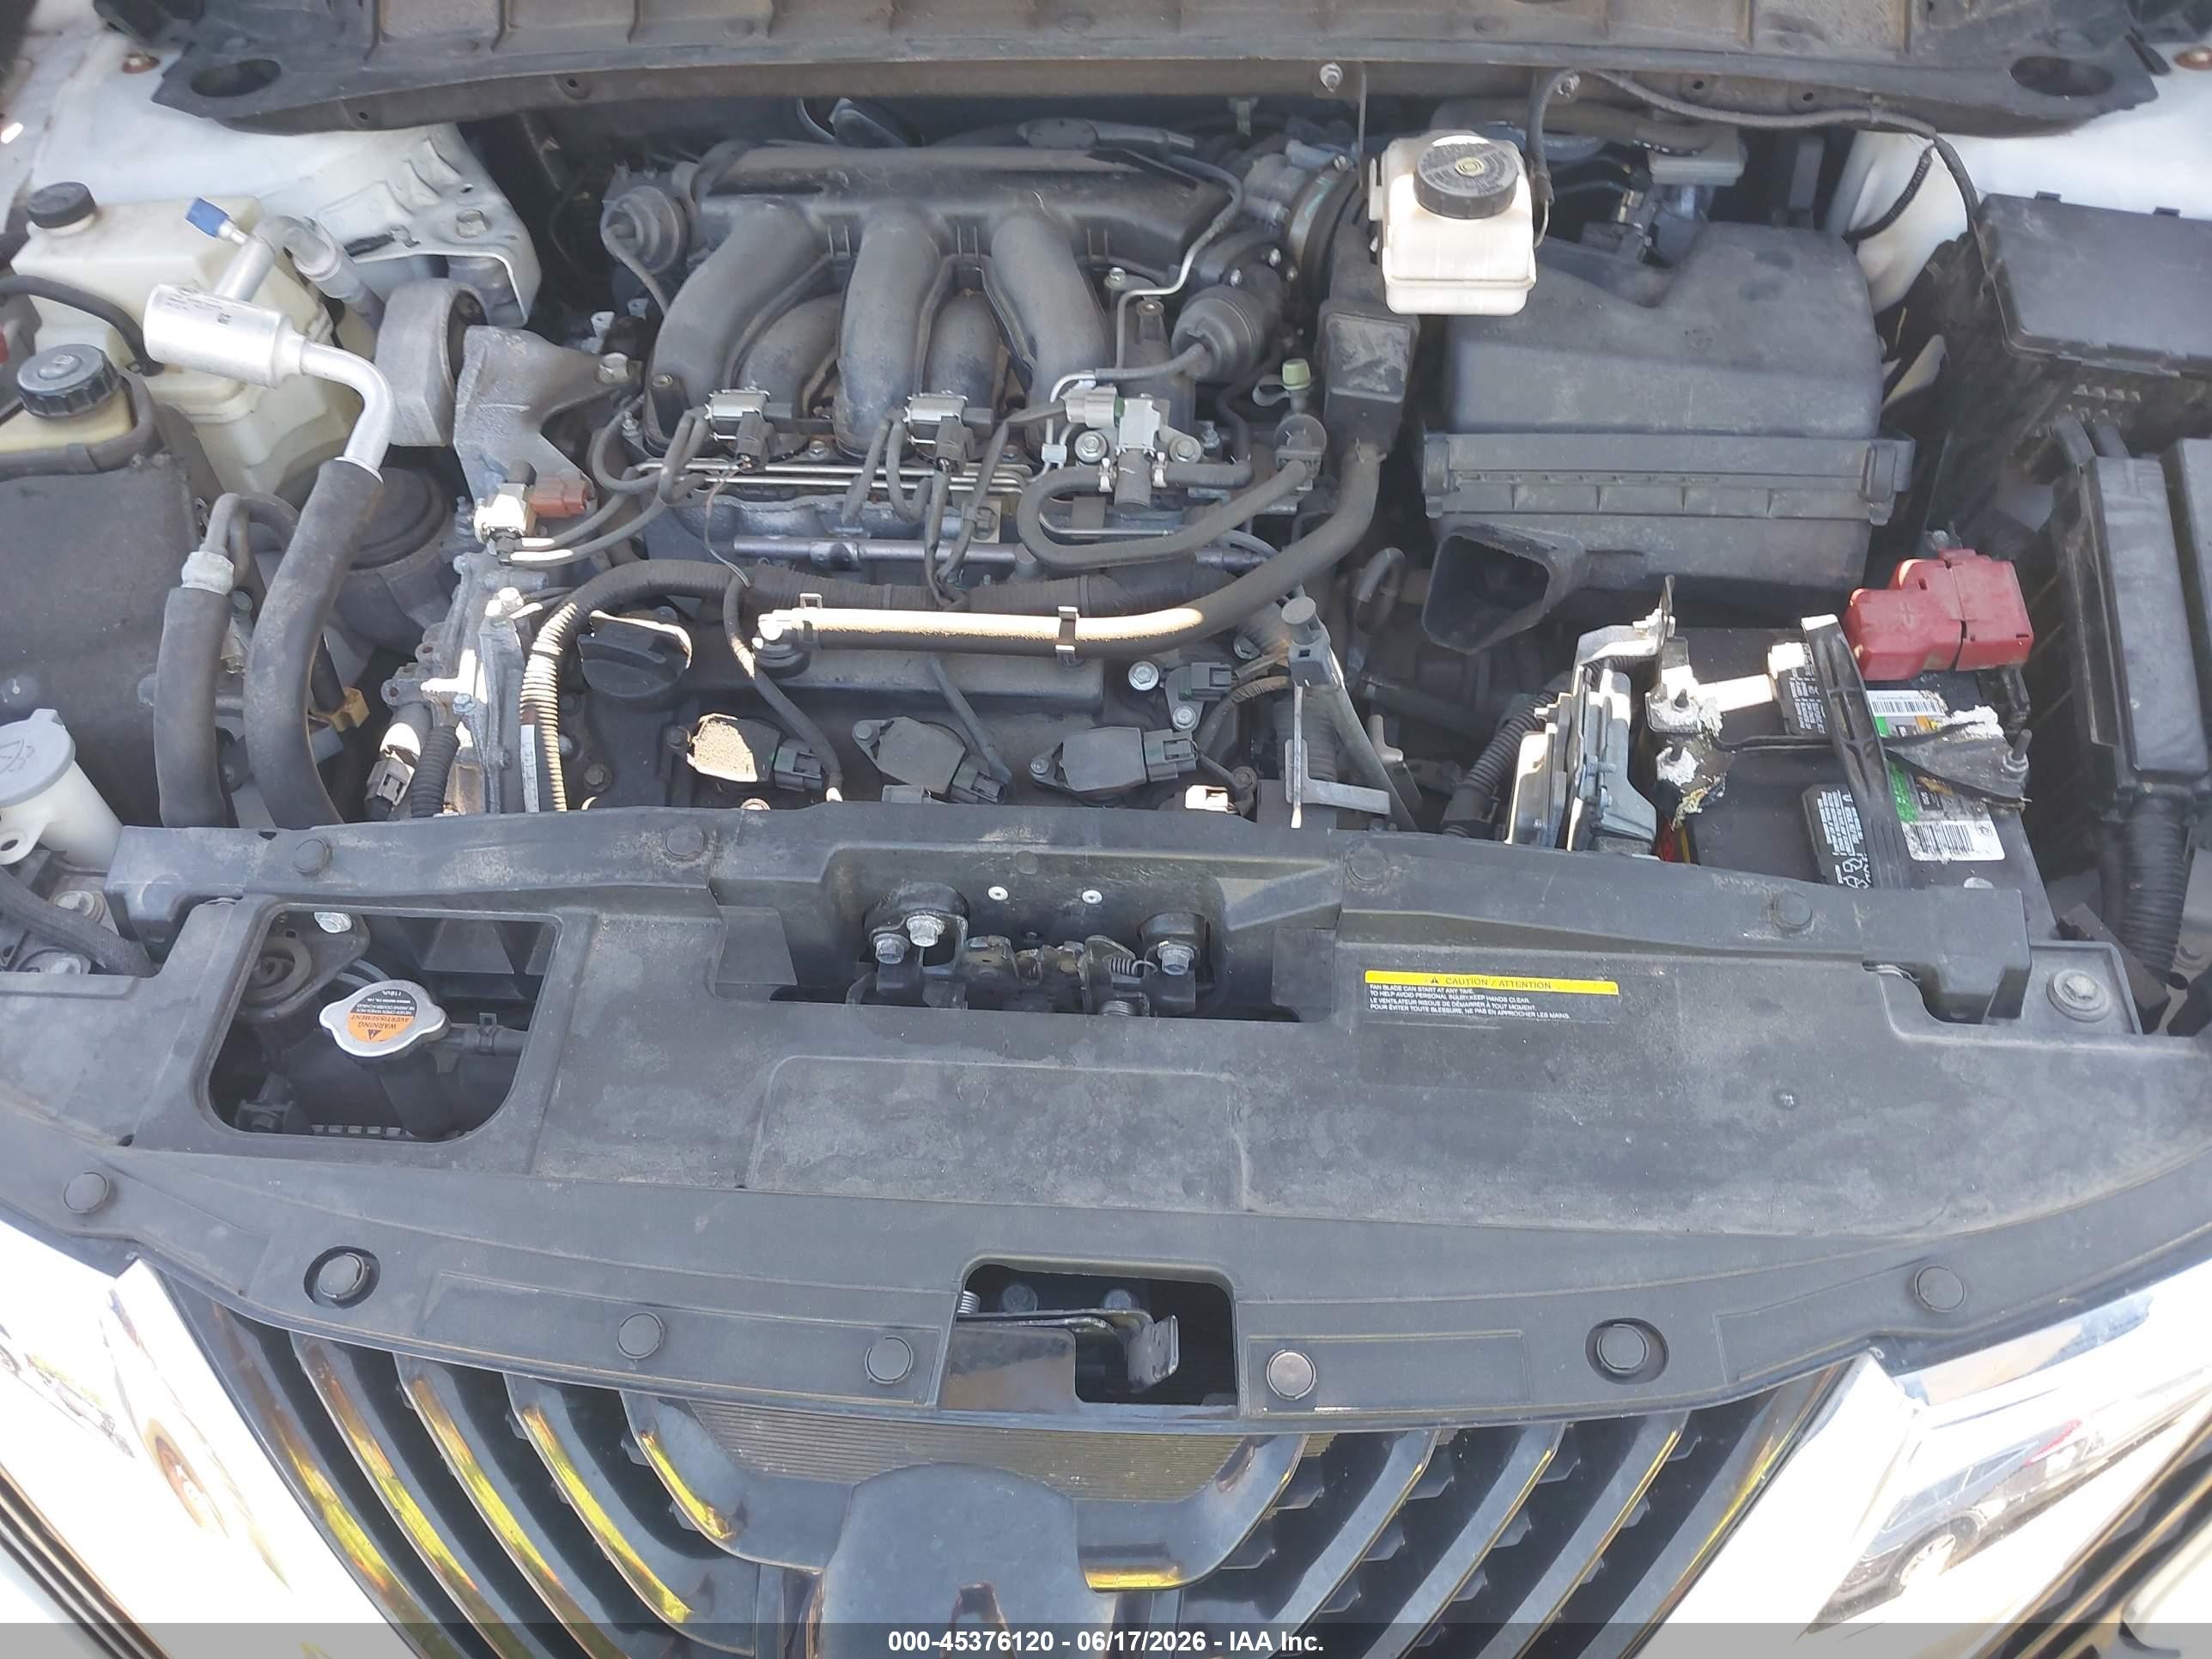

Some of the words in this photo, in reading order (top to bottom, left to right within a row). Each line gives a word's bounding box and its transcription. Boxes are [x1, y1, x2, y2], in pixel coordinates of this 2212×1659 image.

[1445, 977, 1488, 986] CAUTION
[1498, 980, 1552, 989] ATTENTION
[1498, 1009, 1535, 1018] APPROCHER
[350, 1014, 410, 1023] AVERTISSEMENT
